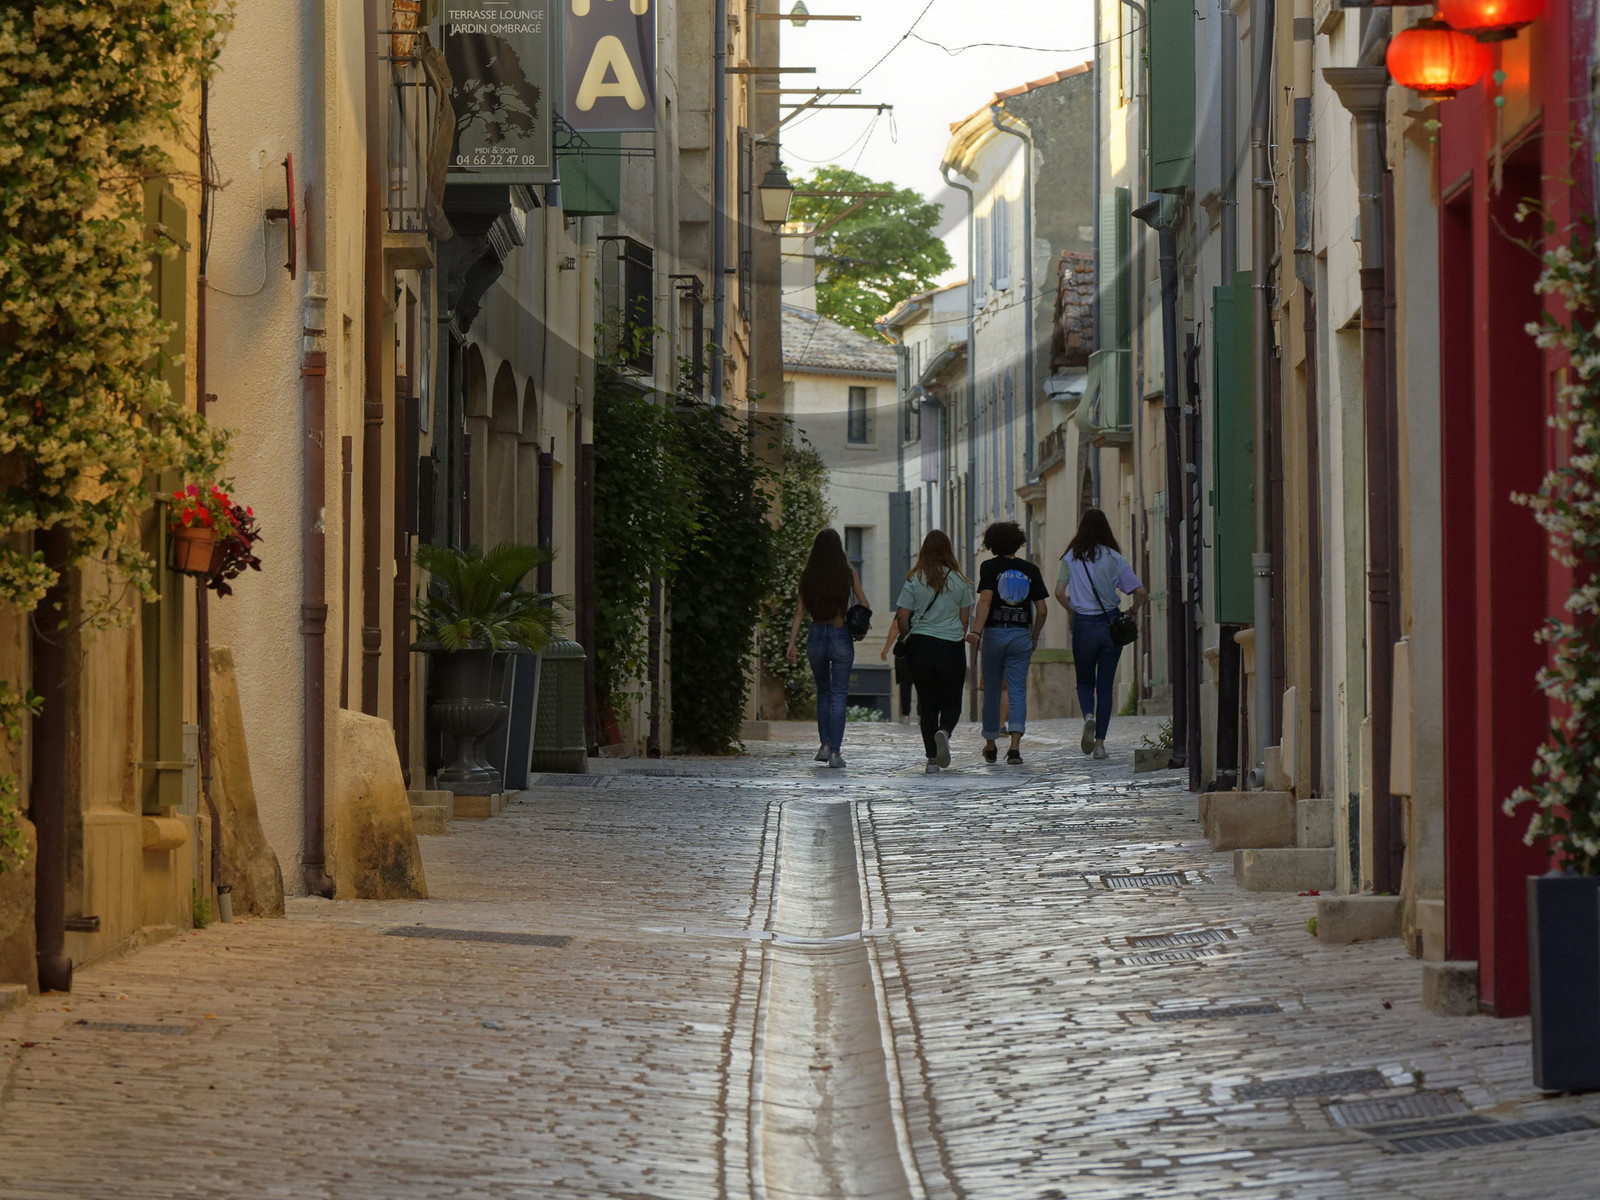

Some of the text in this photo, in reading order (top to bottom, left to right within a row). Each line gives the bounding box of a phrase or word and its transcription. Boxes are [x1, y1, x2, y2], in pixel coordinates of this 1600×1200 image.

[448, 9, 544, 20] TERRASSE LOUNGE
[449, 21, 542, 36] JARDIN OMBRAGÉ
[491, 146, 499, 154] &
[456, 155, 535, 165] 04 66 22 47 08
